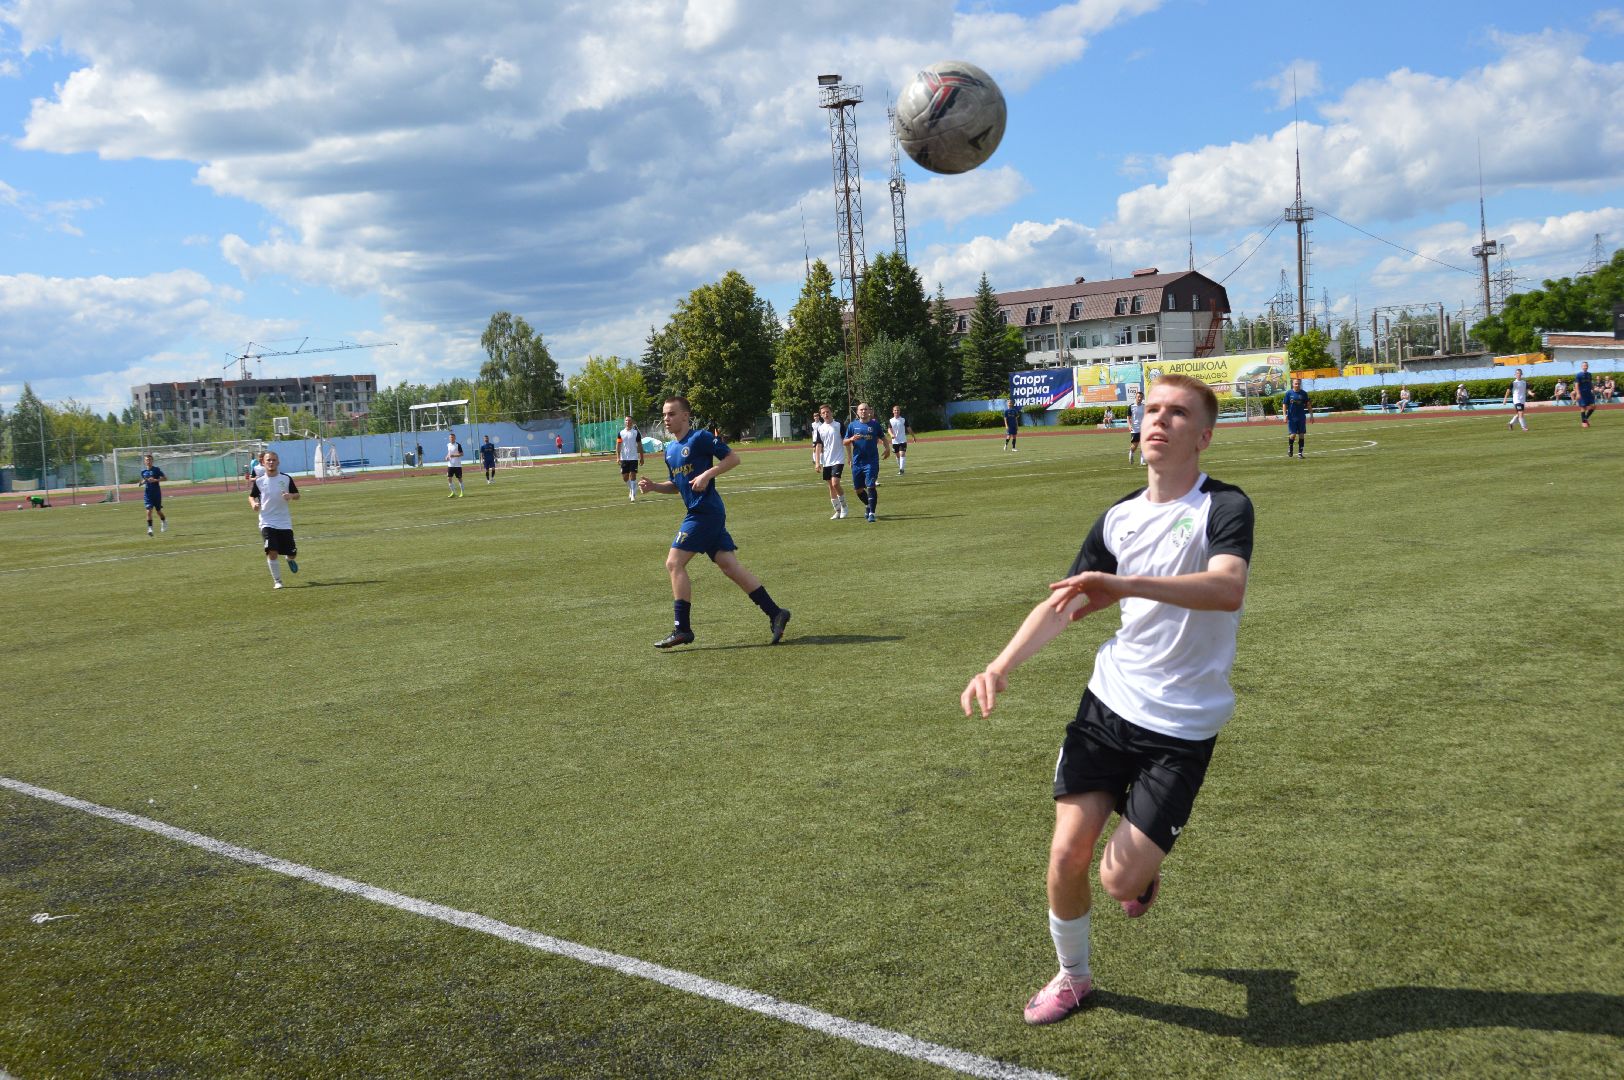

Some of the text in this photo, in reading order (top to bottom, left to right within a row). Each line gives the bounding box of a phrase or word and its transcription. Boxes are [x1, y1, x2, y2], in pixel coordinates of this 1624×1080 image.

[1169, 360, 1228, 373] АВТОШКОЛА
[1012, 374, 1047, 386] Спорт
[1013, 385, 1050, 398] норма
[1013, 394, 1054, 407] жизни!
